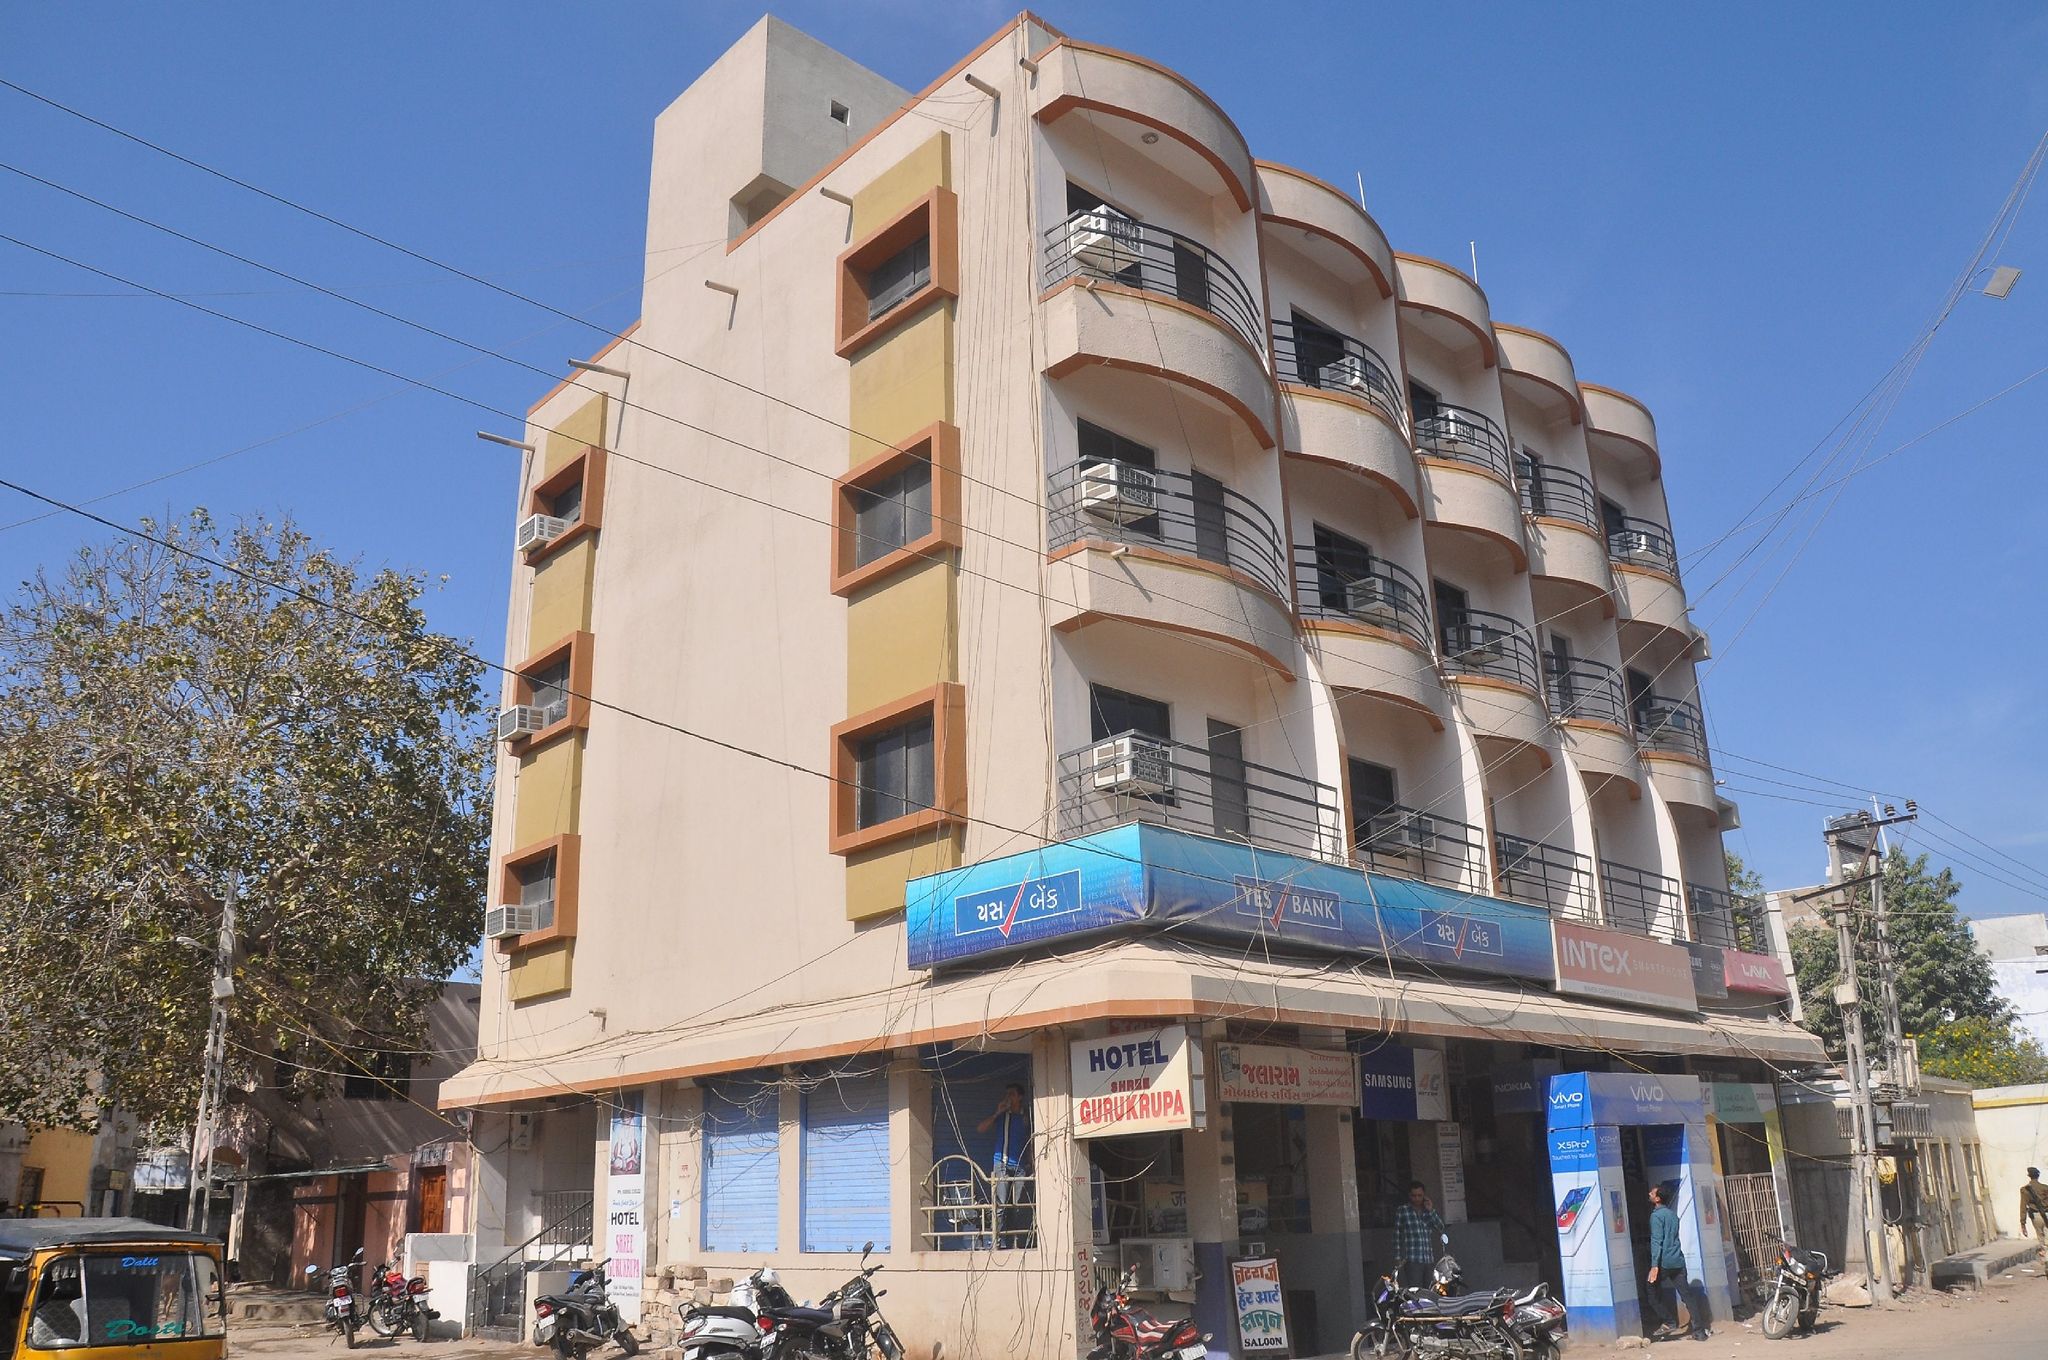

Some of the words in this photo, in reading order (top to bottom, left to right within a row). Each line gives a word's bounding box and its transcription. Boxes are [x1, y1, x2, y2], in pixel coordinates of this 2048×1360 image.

[976, 900, 1003, 923] યસ
[1241, 884, 1272, 909] YES
[1292, 895, 1336, 920] BANK
[1437, 918, 1456, 940] યસ
[1741, 963, 1771, 981] LAVA
[1089, 1040, 1169, 1073] HOTEL
[1240, 1063, 1301, 1087] જલારામ
[1364, 1073, 1413, 1090] SAMSUNG
[1110, 1077, 1151, 1094] SHREE
[1079, 1089, 1185, 1126] GURUKRUPA
[1549, 1092, 1583, 1104] vivo
[611, 1212, 640, 1227] HOTEL
[121, 1256, 159, 1269] Dalit
[105, 1318, 187, 1339] Dosti
[1244, 1336, 1283, 1348] SALOON
